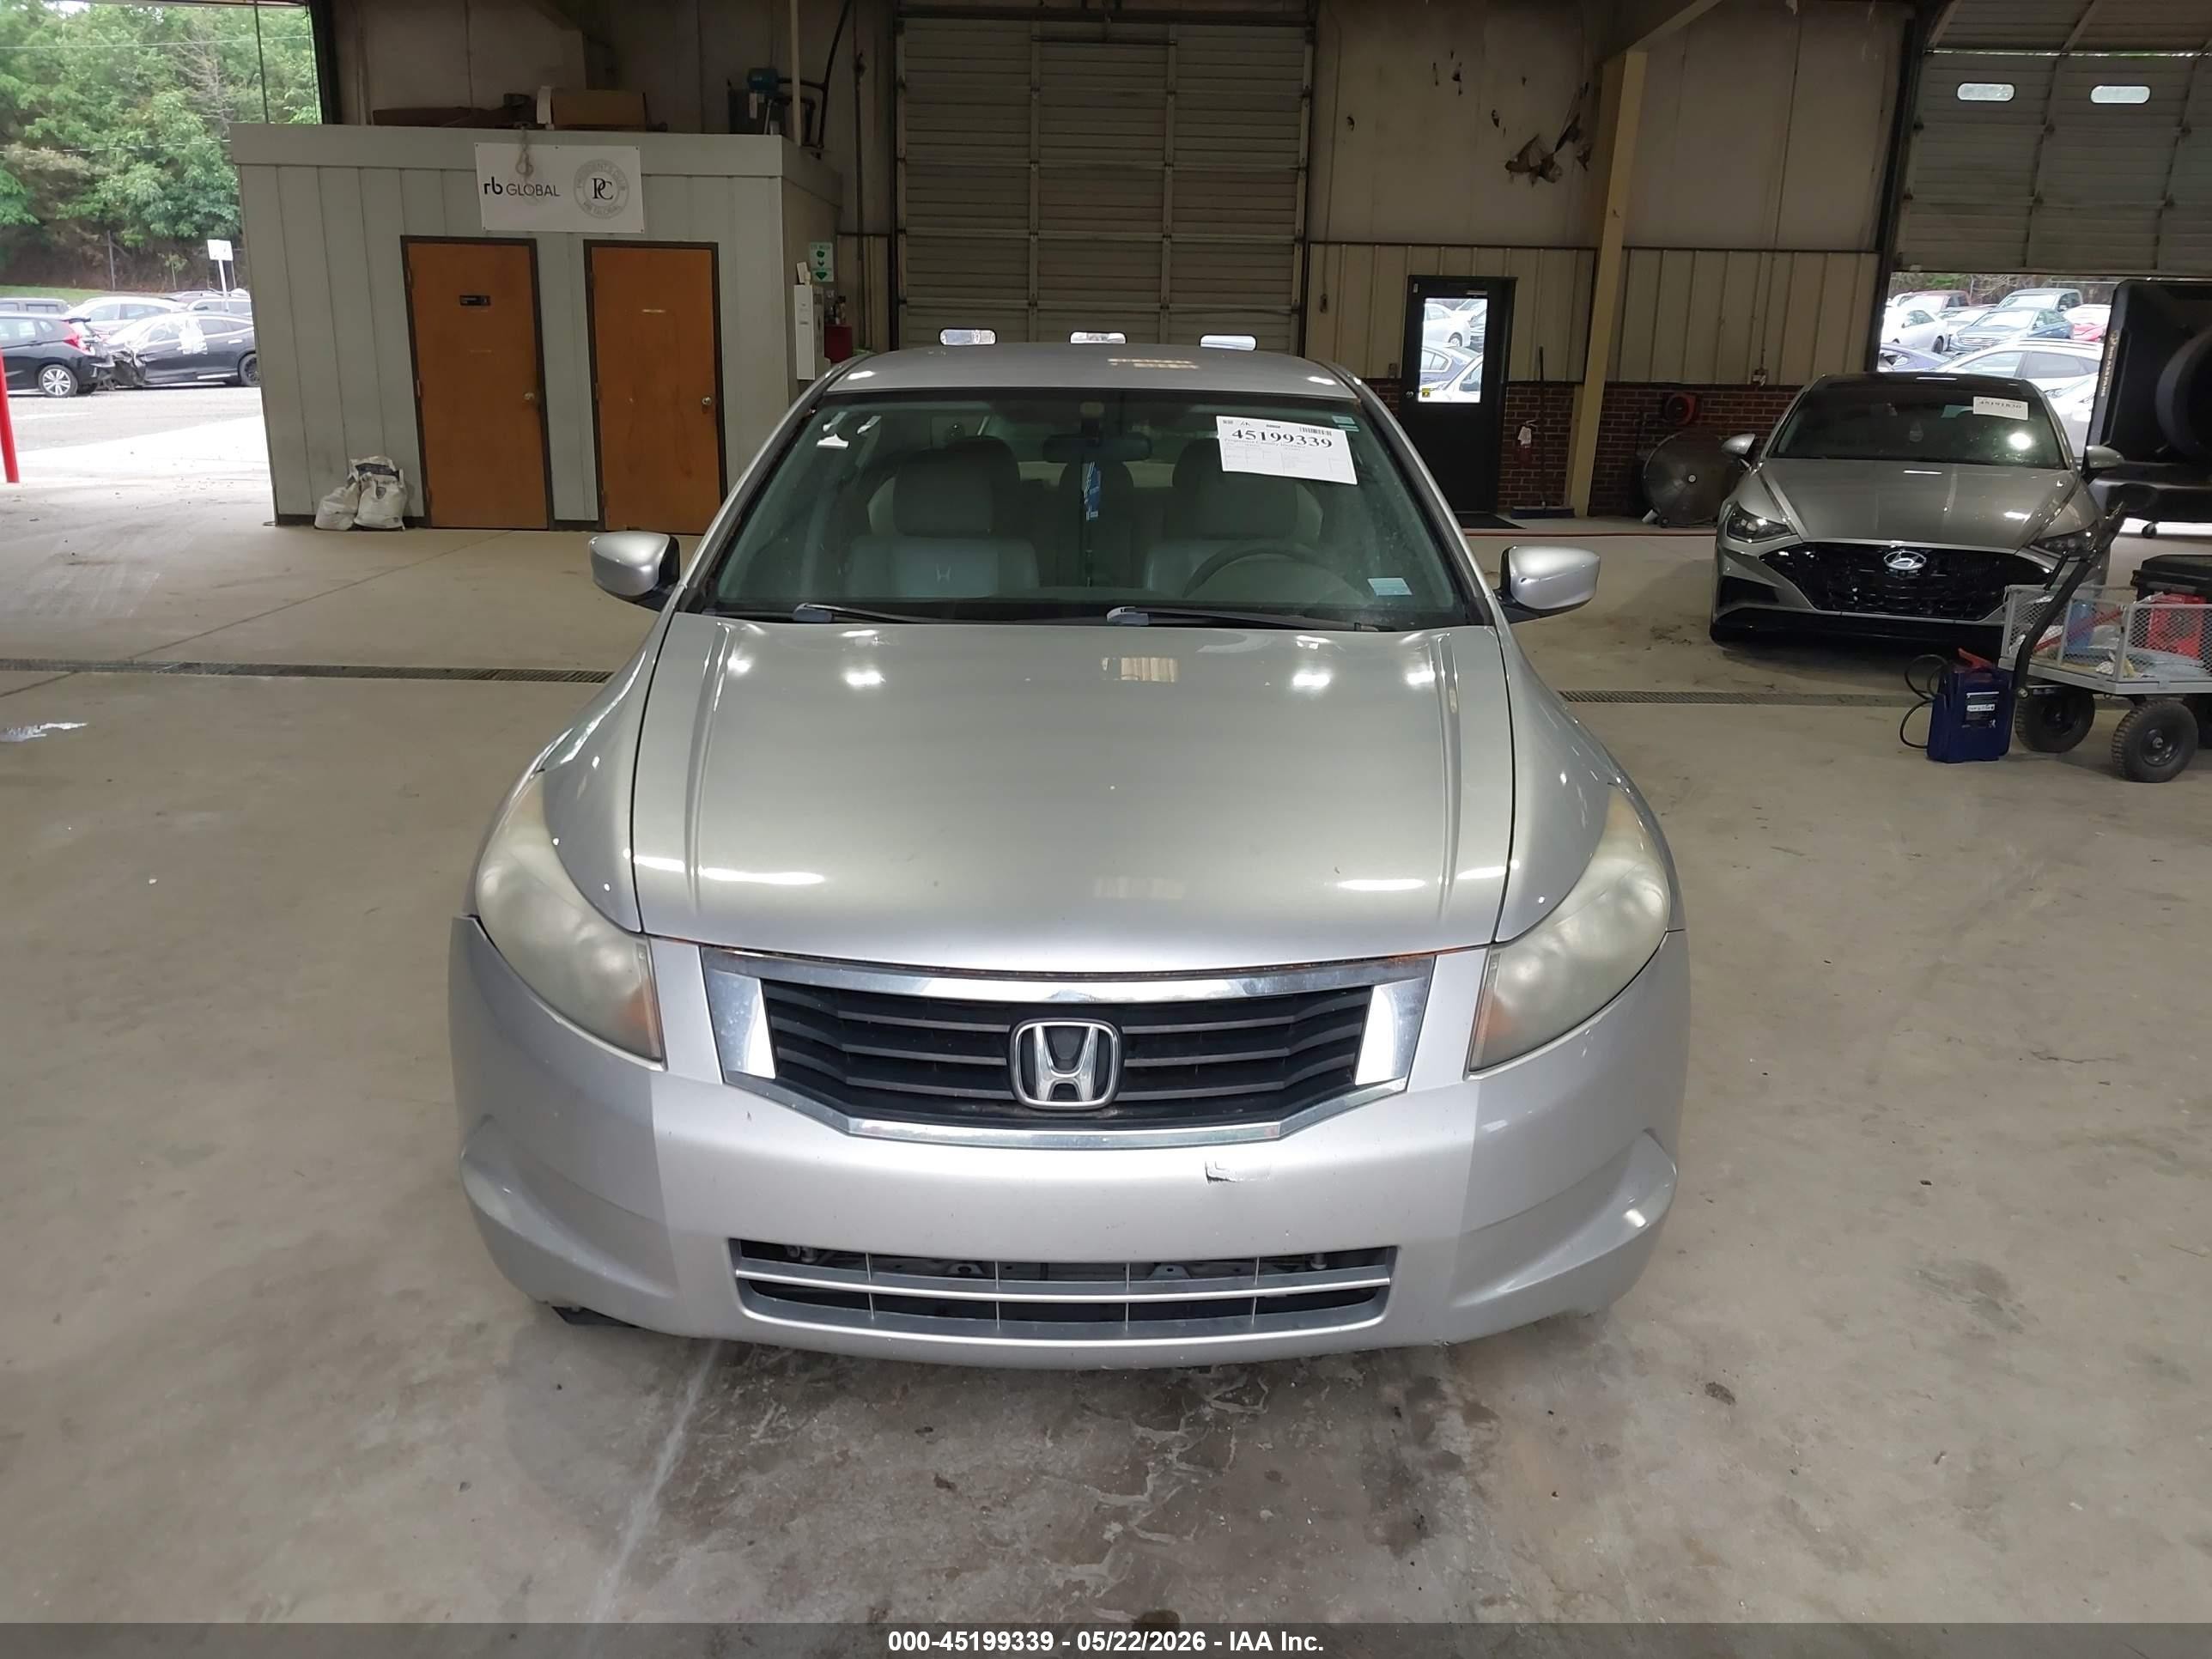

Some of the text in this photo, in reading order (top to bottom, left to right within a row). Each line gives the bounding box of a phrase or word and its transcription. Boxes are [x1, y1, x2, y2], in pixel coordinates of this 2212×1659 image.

[483, 176, 561, 198] rb GLOBAL
[1231, 428, 1333, 448] 45199339
